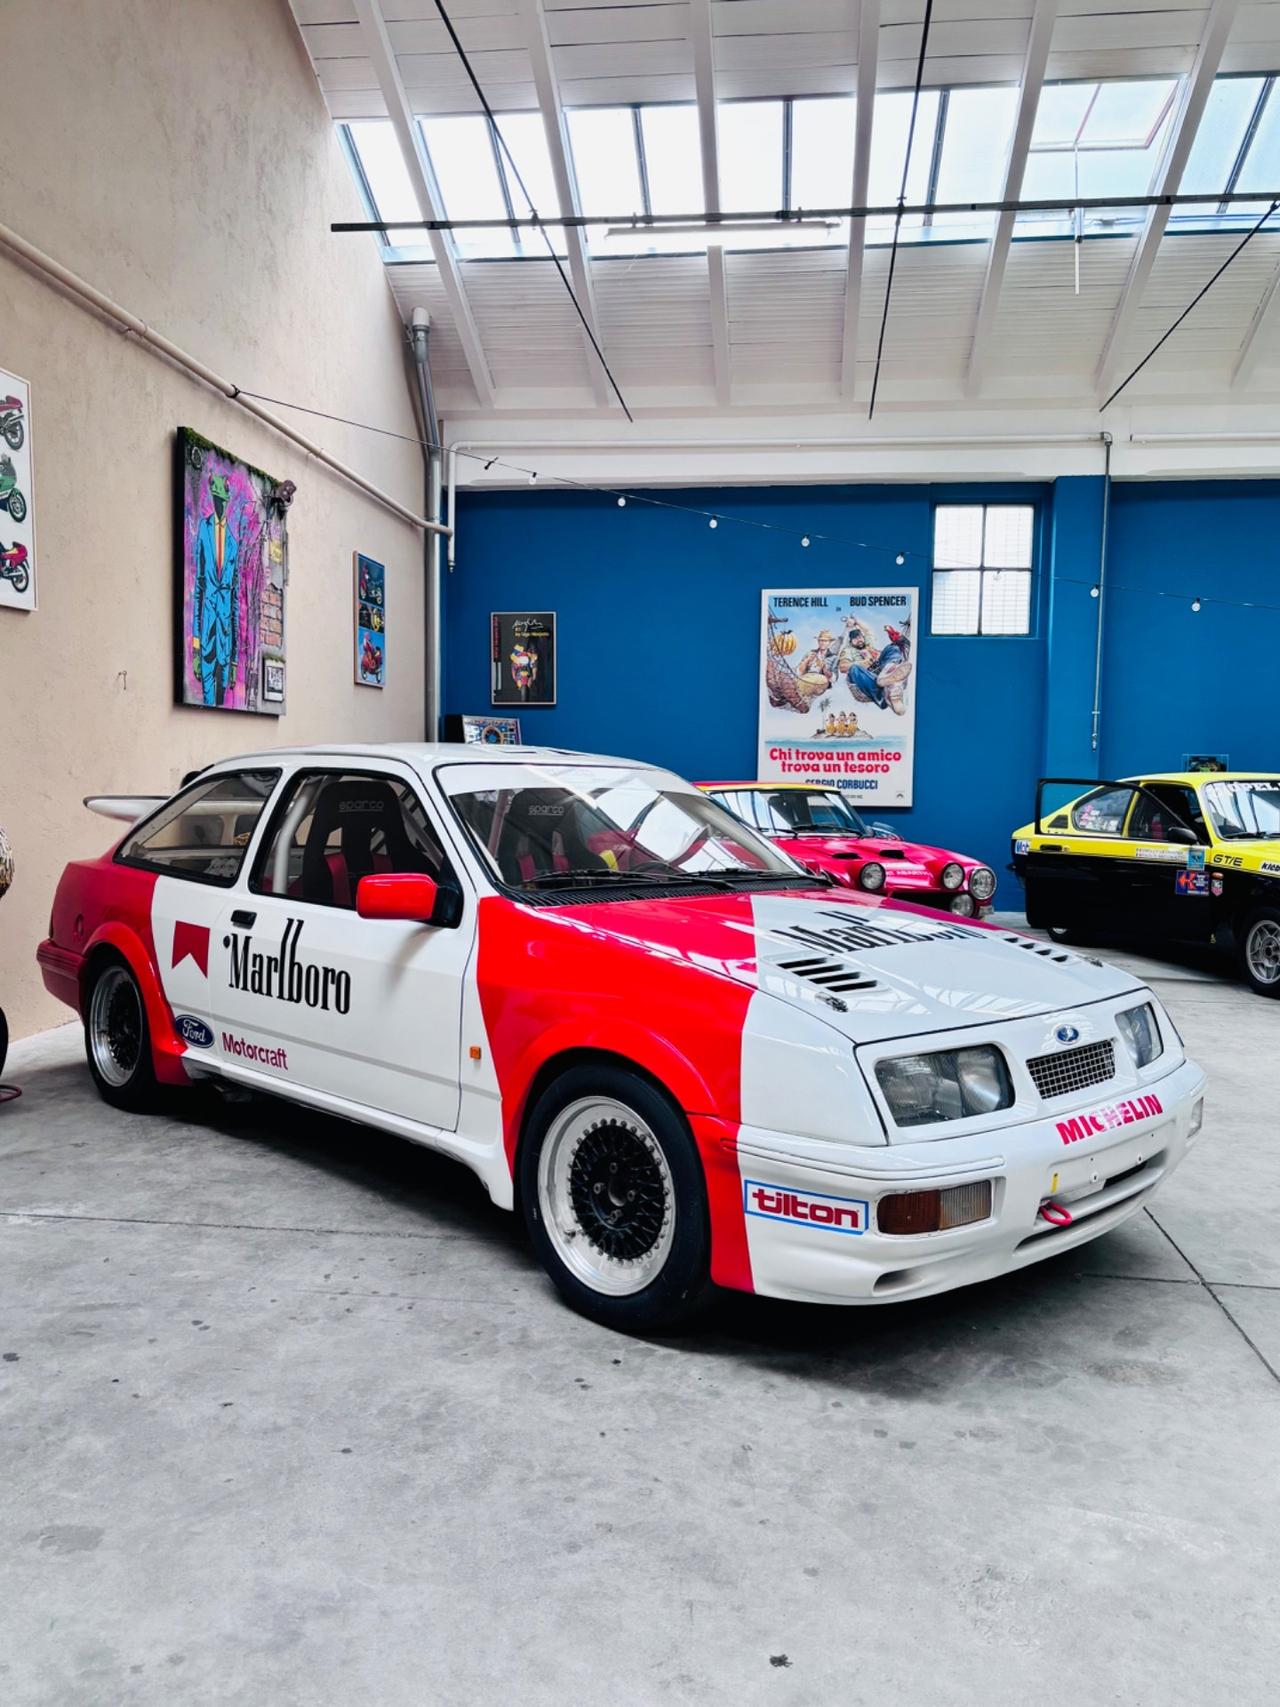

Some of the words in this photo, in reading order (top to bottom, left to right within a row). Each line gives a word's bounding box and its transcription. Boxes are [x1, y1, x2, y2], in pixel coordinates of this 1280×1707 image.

[773, 597, 809, 607] TERENCE
[811, 597, 828, 607] HILL
[849, 596, 866, 607] BUD
[868, 596, 906, 607] SPENCER
[769, 748, 792, 761] Chi
[796, 749, 833, 761] trova
[836, 752, 854, 761] un
[857, 749, 902, 761] amico
[781, 761, 819, 773] trova
[823, 764, 840, 773] un
[844, 761, 890, 773] tesoro
[836, 779, 878, 790] CORBUCCI
[337, 800, 384, 811] sparco
[1213, 854, 1243, 867] GT/E
[229, 917, 351, 1015] Marlboro
[182, 1019, 206, 1042] Ford
[222, 1032, 289, 1070] Motorcraft
[1056, 1094, 1164, 1146] MICHELIN
[752, 1188, 859, 1228] tilton
